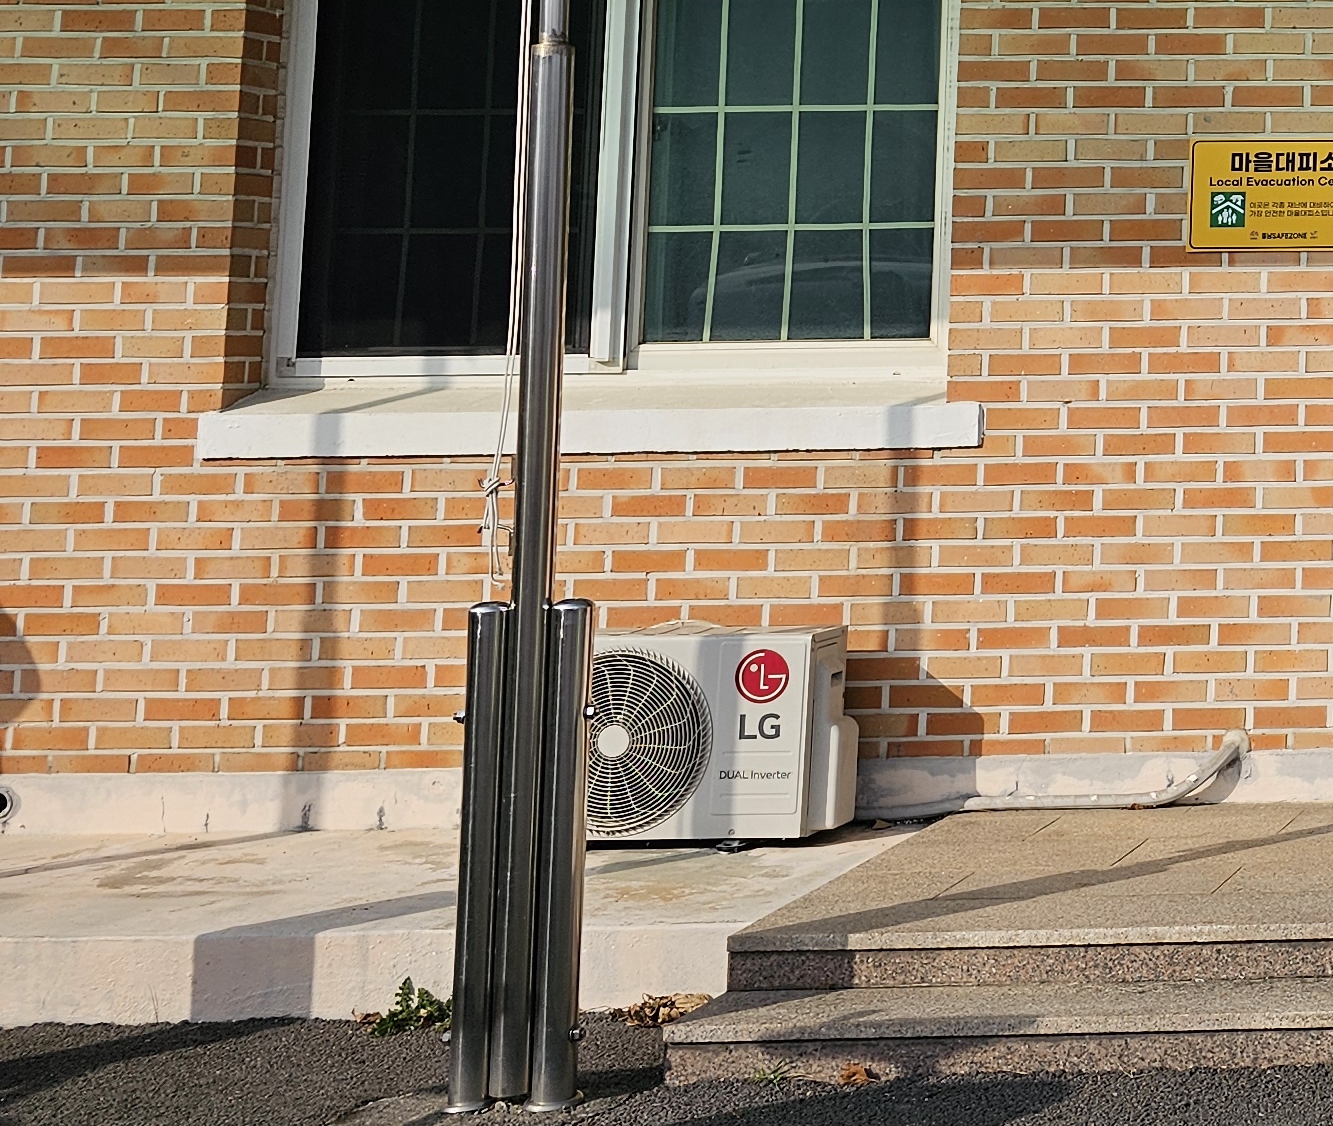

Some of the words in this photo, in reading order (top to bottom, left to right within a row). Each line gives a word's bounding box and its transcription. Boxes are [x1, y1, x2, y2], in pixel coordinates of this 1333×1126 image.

[1209, 176, 1243, 187] Local
[1246, 176, 1315, 187] Evacuation
[738, 713, 781, 741] LG
[719, 770, 749, 780] DUAL
[750, 770, 791, 780] Inverter
